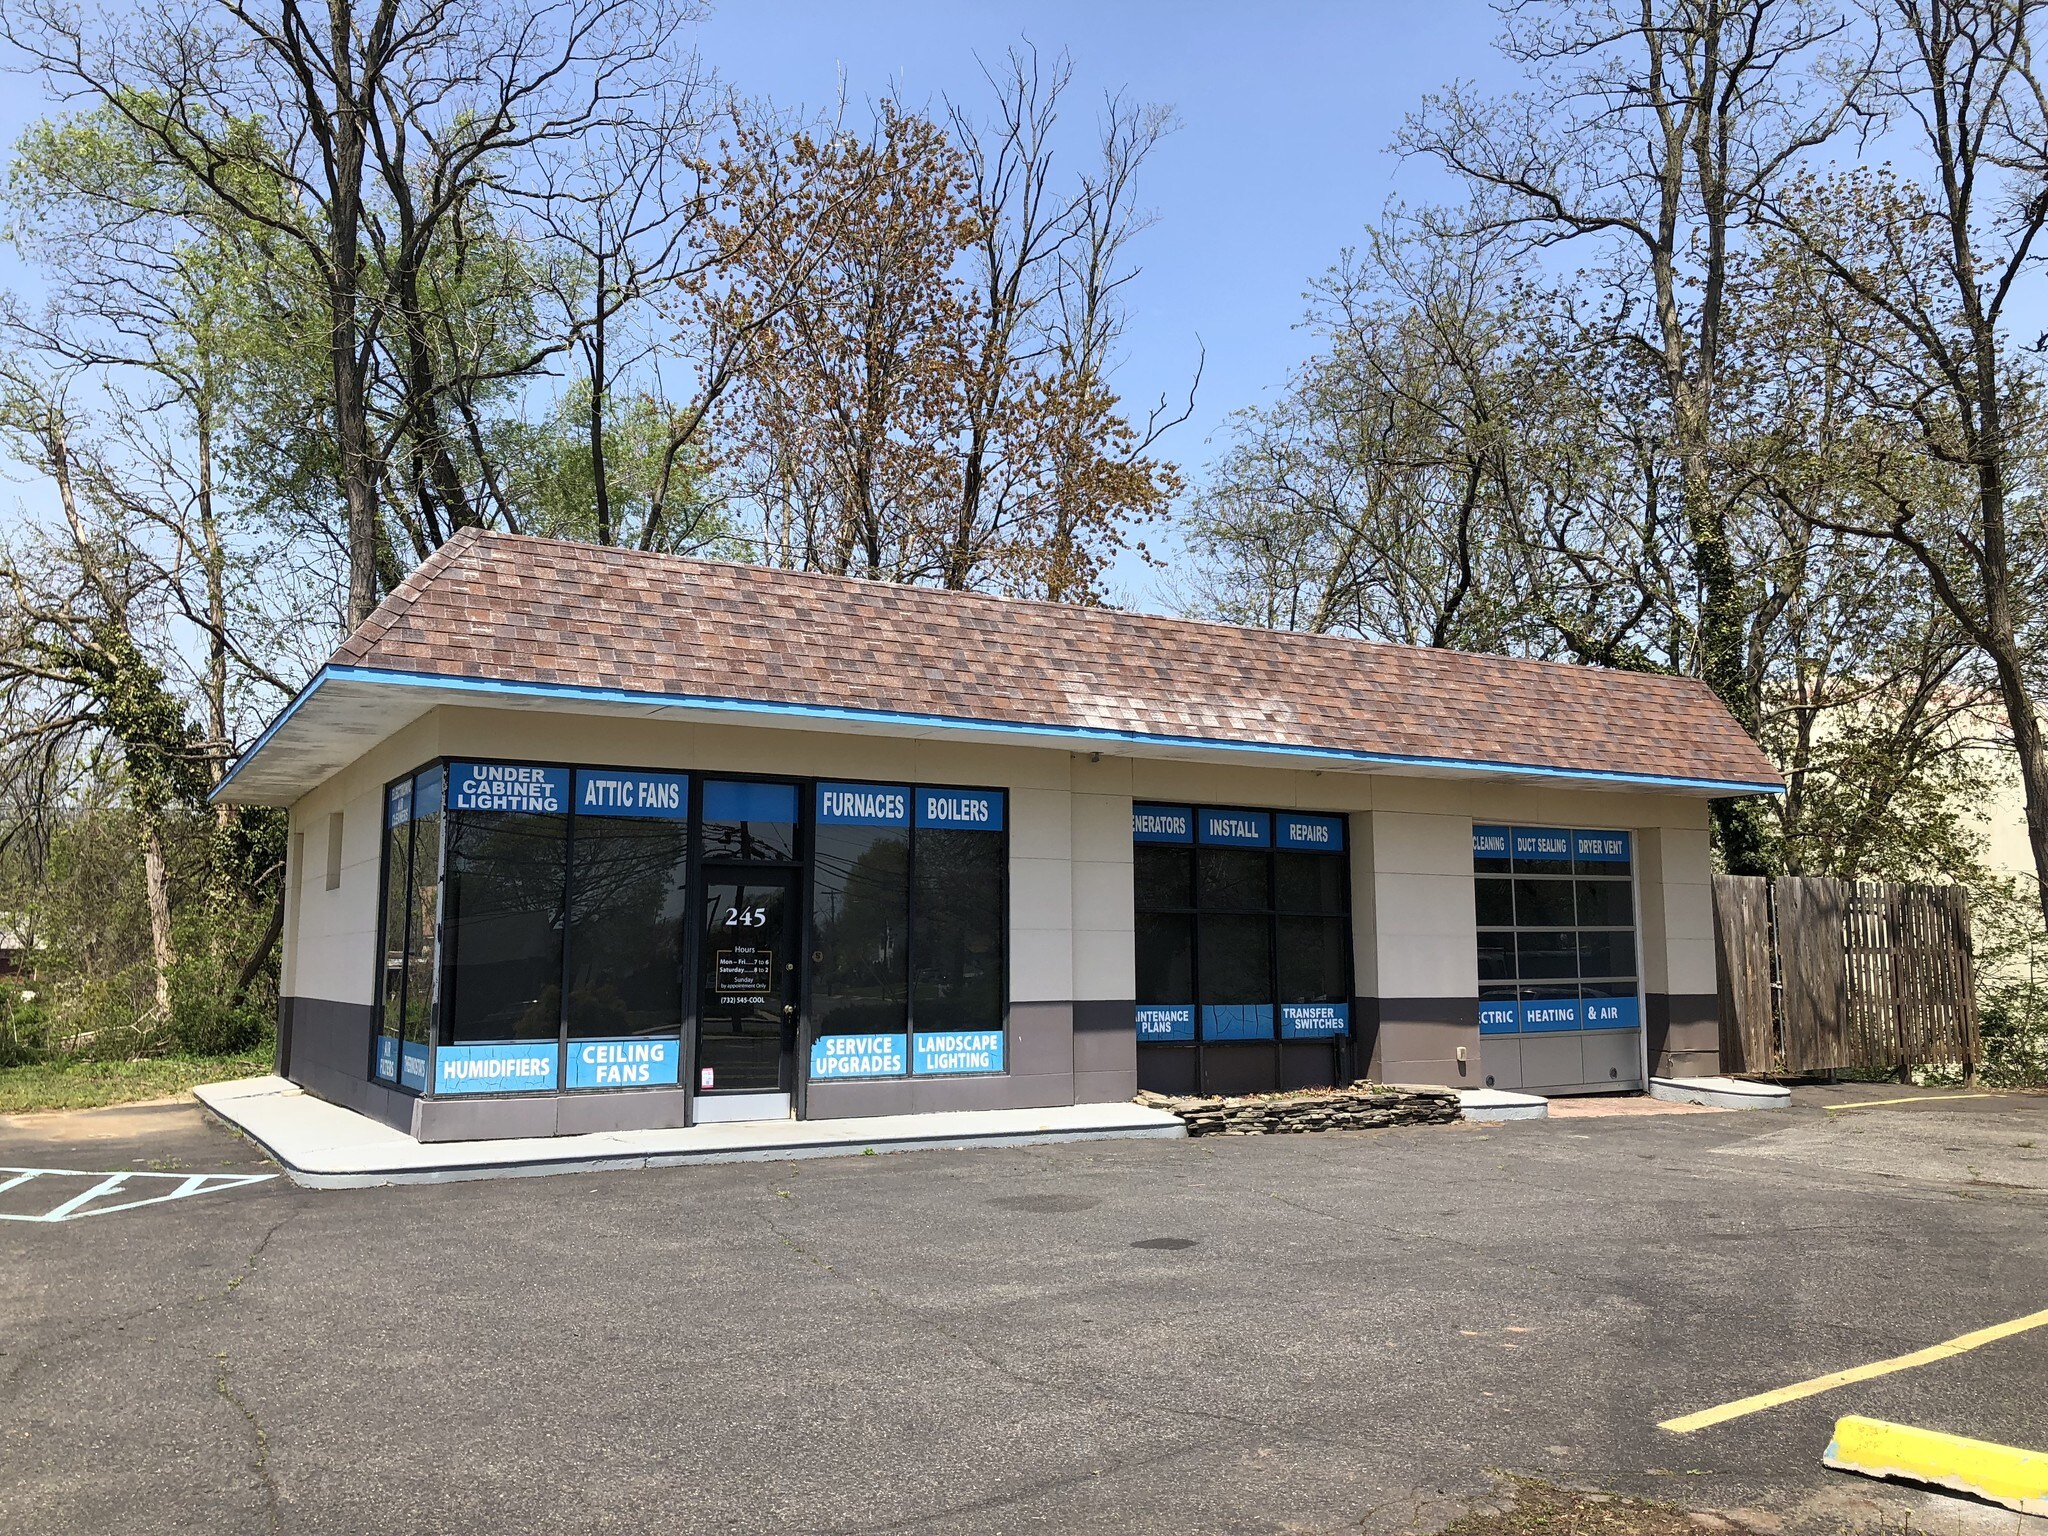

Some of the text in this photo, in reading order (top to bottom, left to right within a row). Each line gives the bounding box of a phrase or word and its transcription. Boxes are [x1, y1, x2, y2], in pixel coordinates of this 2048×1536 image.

[473, 766, 545, 783] UNDER
[462, 780, 555, 797] CABINET
[584, 780, 680, 809] ATTIC FANS
[458, 794, 558, 811] LIGHTING
[823, 792, 904, 819] FURNACES
[928, 798, 988, 822] BOILERS
[1210, 818, 1258, 838] INSTALL
[1290, 824, 1328, 842] REPAIRS
[1472, 836, 1504, 851] CLEANING
[1517, 837, 1566, 853] DUCT SEALING
[1578, 839, 1622, 854] DRYER VENT
[725, 906, 766, 928] 245
[1136, 1011, 1188, 1022] INTENANCE
[1283, 1008, 1334, 1018] TRANSFER
[1527, 1008, 1574, 1022] HEATING
[1588, 1006, 1596, 1020] &
[1600, 1007, 1618, 1019] AIR
[1142, 1022, 1171, 1033] PLANS
[1295, 1018, 1344, 1029] SWITCHES
[826, 1037, 892, 1055] SERVICE
[918, 1034, 997, 1052] LANDSCAPE
[582, 1044, 664, 1064] CEILING
[927, 1052, 989, 1070] LIGHTING
[443, 1058, 550, 1079] HUMIDIFIERS
[596, 1064, 650, 1083] FANS
[816, 1055, 901, 1074] UPGRADES
